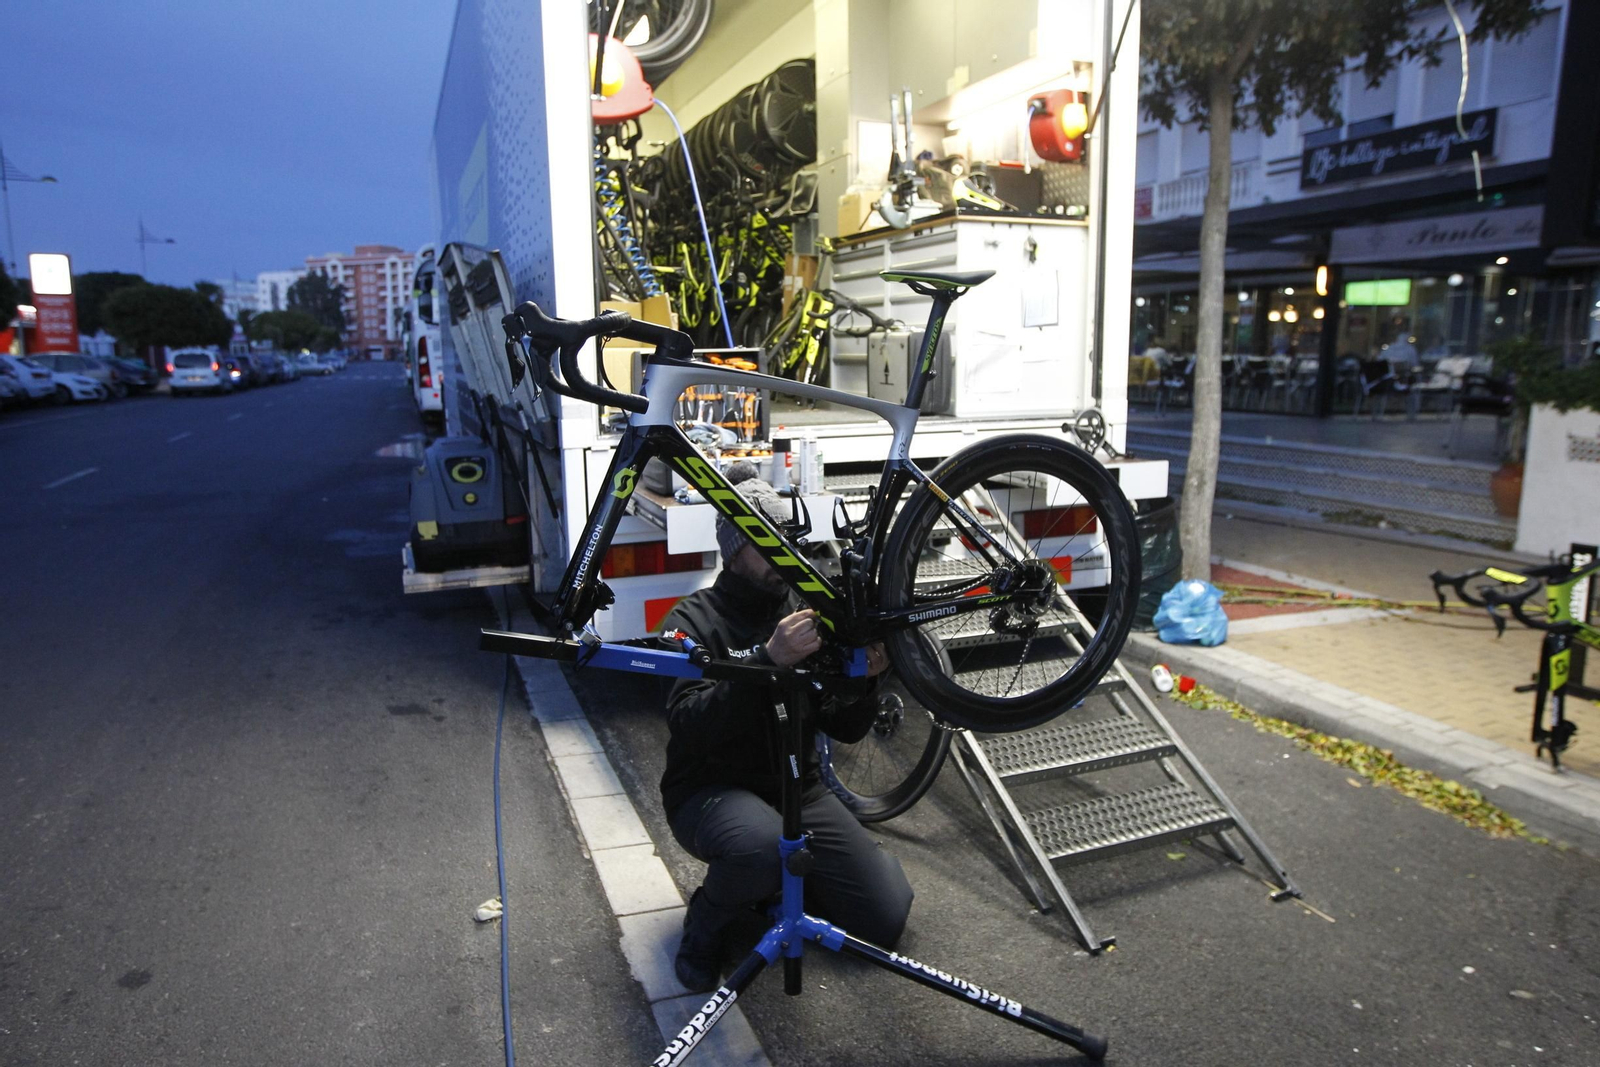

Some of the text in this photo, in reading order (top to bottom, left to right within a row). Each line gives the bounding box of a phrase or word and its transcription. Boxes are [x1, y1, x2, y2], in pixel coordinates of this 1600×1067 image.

[673, 456, 835, 600] SCOTT
[572, 524, 603, 589] MITCHELTON
[908, 605, 957, 623] SHIMANO
[978, 595, 1012, 604] SCOTT
